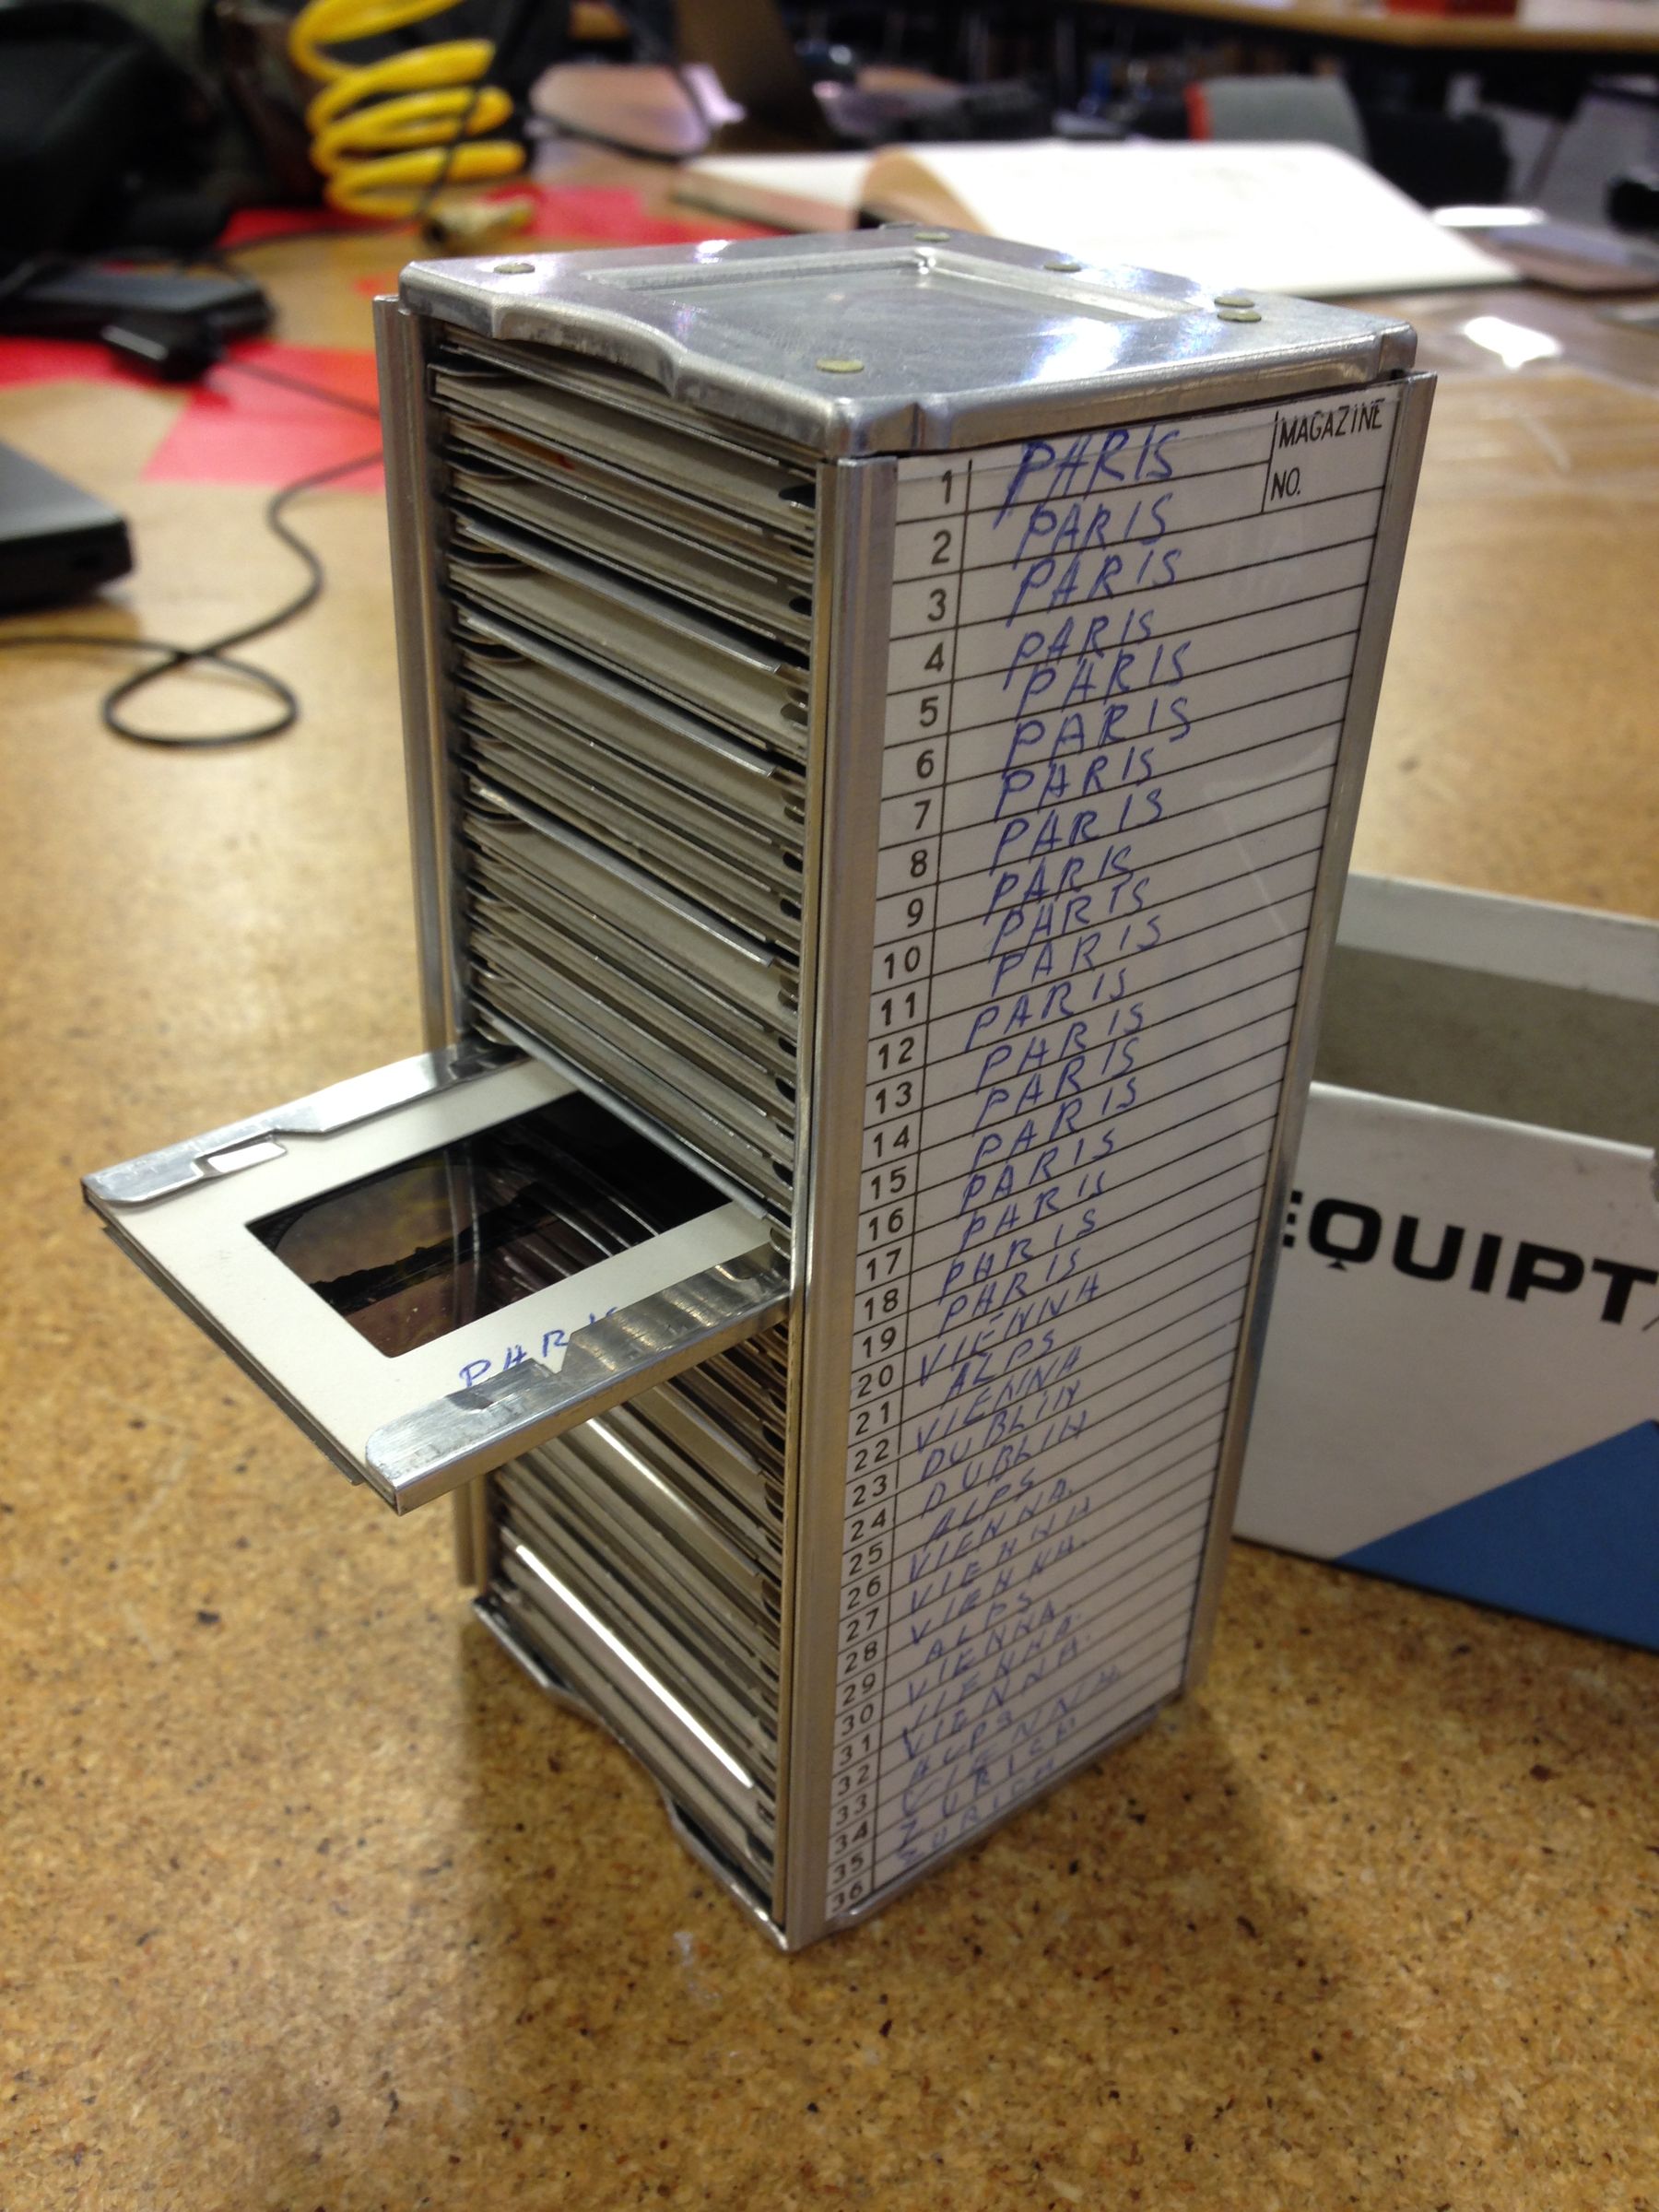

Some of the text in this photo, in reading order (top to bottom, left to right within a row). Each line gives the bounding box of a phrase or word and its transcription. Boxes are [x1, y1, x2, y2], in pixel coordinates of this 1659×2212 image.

[1278, 397, 1385, 449] MAGAZINE
[941, 469, 953, 504] 1
[993, 425, 1180, 530] PARIS
[1270, 466, 1301, 501] NO.
[931, 529, 952, 565] 2
[1012, 492, 1173, 570] PARIS
[927, 588, 947, 622] 3
[1006, 548, 1182, 628] PARIS
[924, 642, 945, 673] 4
[1003, 608, 1155, 690] PARIS
[1015, 641, 1192, 723] PARIS
[920, 697, 939, 728] 5
[1002, 697, 1192, 779] PARIS
[916, 749, 935, 779] 6
[994, 746, 1155, 822] PARIS
[913, 799, 932, 830] 7
[989, 788, 1162, 877] PARIS
[911, 849, 928, 877] 8
[983, 845, 1135, 925] PARIS
[907, 899, 924, 927] 9
[988, 877, 1150, 963] PARIS
[884, 946, 921, 979] 10
[992, 915, 1161, 997] PARIS
[881, 992, 916, 1026] 11
[965, 968, 1126, 1053] PARIS
[878, 1037, 914, 1070] 12
[975, 1002, 1144, 1094] PARIS
[876, 1081, 912, 1114] 13
[971, 1037, 1140, 1136] PARIS
[873, 1124, 910, 1158] 14
[969, 1077, 1136, 1175] PARIS
[871, 1166, 907, 1199] 15
[957, 1127, 1115, 1219] PARIS
[868, 1207, 904, 1241] 16
[959, 1171, 1105, 1254] PARIS
[866, 1247, 901, 1281] 17
[938, 1208, 1096, 1305] PARIS
[865, 1288, 899, 1322] 18
[937, 1247, 1081, 1339] PARIS
[863, 1326, 896, 1358] 19
[920, 1272, 1100, 1387] VIENNA
[857, 1364, 893, 1399] 20
[940, 1328, 1055, 1410] ALPS
[917, 1345, 1083, 1453] VIENNA
[855, 1401, 889, 1436] 21
[921, 1380, 1081, 1482] DUBLIN
[854, 1439, 889, 1471] 22
[921, 1409, 1088, 1519] DUBLIN
[852, 1475, 887, 1508] 23
[850, 1508, 886, 1543] 24
[849, 1545, 883, 1576] 25
[847, 1576, 882, 1610] 26
[845, 1608, 879, 1642] 27
[844, 1641, 877, 1674] 28
[843, 1673, 876, 1704] 29
[841, 1704, 874, 1736] 30
[839, 1734, 870, 1765] 31
[838, 1764, 869, 1795] 32
[836, 1794, 867, 1825] 33
[835, 1821, 867, 1853] 34
[833, 1851, 865, 1883] 35
